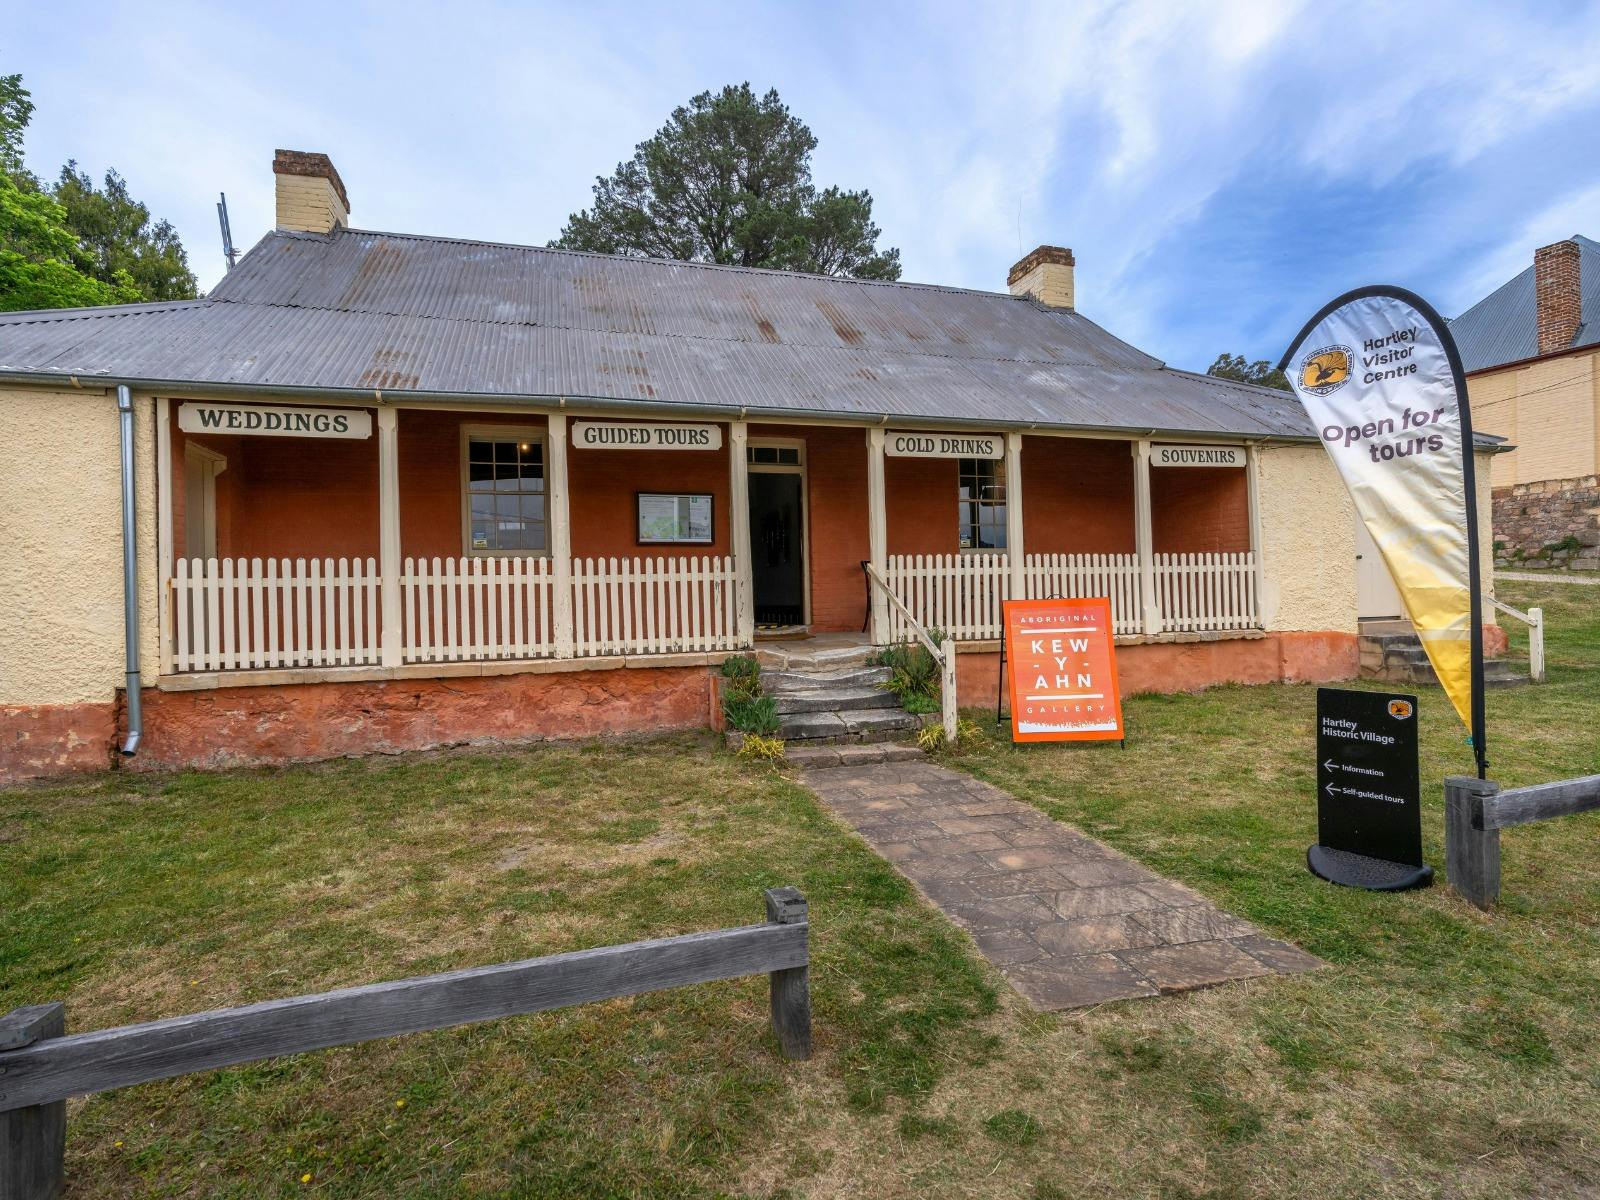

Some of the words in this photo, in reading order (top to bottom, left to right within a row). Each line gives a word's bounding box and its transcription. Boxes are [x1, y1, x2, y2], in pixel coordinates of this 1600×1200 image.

[1363, 326, 1417, 352] Hartley
[1362, 346, 1415, 368] Visitor
[1363, 363, 1417, 384] Centre
[197, 409, 349, 433] WEDDINGS
[1322, 418, 1394, 448] Open
[1402, 407, 1445, 430] for
[584, 427, 651, 445] GUIDED
[656, 429, 709, 445] TOURS
[895, 436, 935, 454] COLD
[940, 438, 994, 455] DRINKS
[1370, 434, 1444, 463] tours
[1161, 448, 1236, 464] SOUVENIRS
[1020, 615, 1096, 624] ABORIGINAL
[1031, 638, 1089, 654] KEW
[1034, 673, 1092, 690] AHN
[1026, 705, 1105, 714] GALLERY
[1322, 717, 1357, 731] Hartley
[1322, 727, 1359, 740] Historic
[1360, 731, 1395, 745] Village
[1342, 764, 1384, 776] Information
[1342, 787, 1383, 800] Self-guided
[1385, 794, 1405, 804] tours
